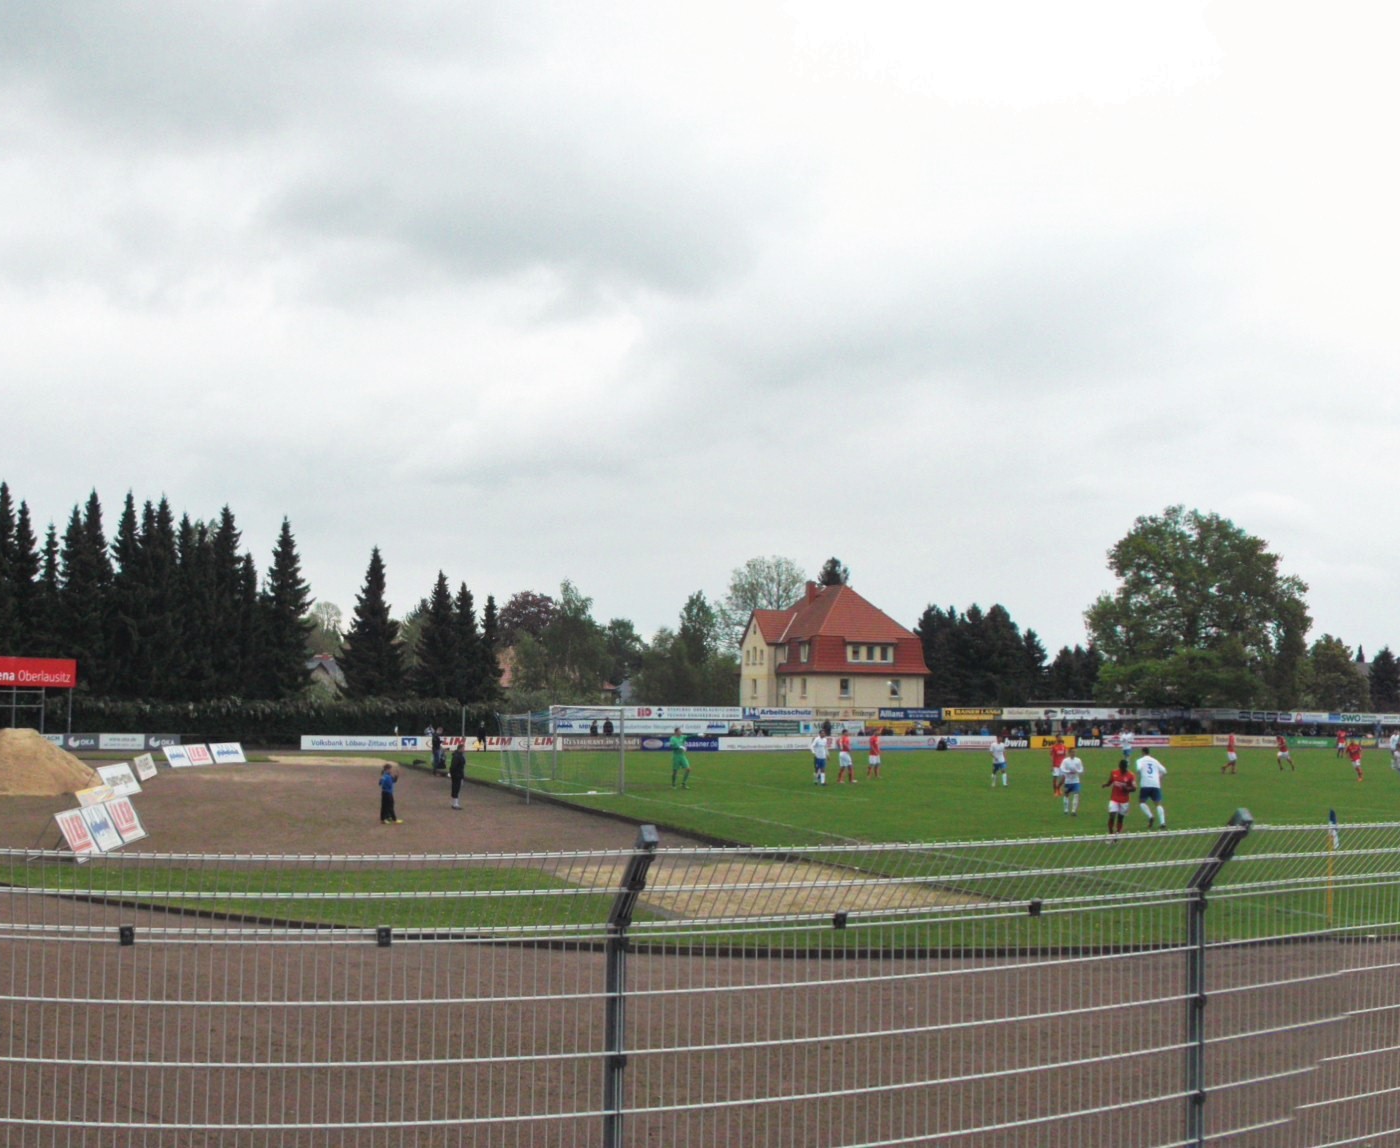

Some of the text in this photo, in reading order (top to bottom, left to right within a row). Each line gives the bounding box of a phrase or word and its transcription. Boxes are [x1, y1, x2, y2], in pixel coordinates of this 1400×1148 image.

[18, 669, 71, 683] Oberlausitz
[760, 708, 812, 716] Arbeitsschutz
[880, 709, 905, 719] Allianz
[1341, 714, 1361, 722] SWO
[80, 738, 95, 746] OKA
[161, 738, 175, 746] OKA
[310, 738, 344, 747] Volksbank
[487, 736, 513, 746] LIM
[1004, 737, 1028, 748] bwin
[1077, 736, 1101, 748] bwin
[1146, 762, 1154, 775] 3
